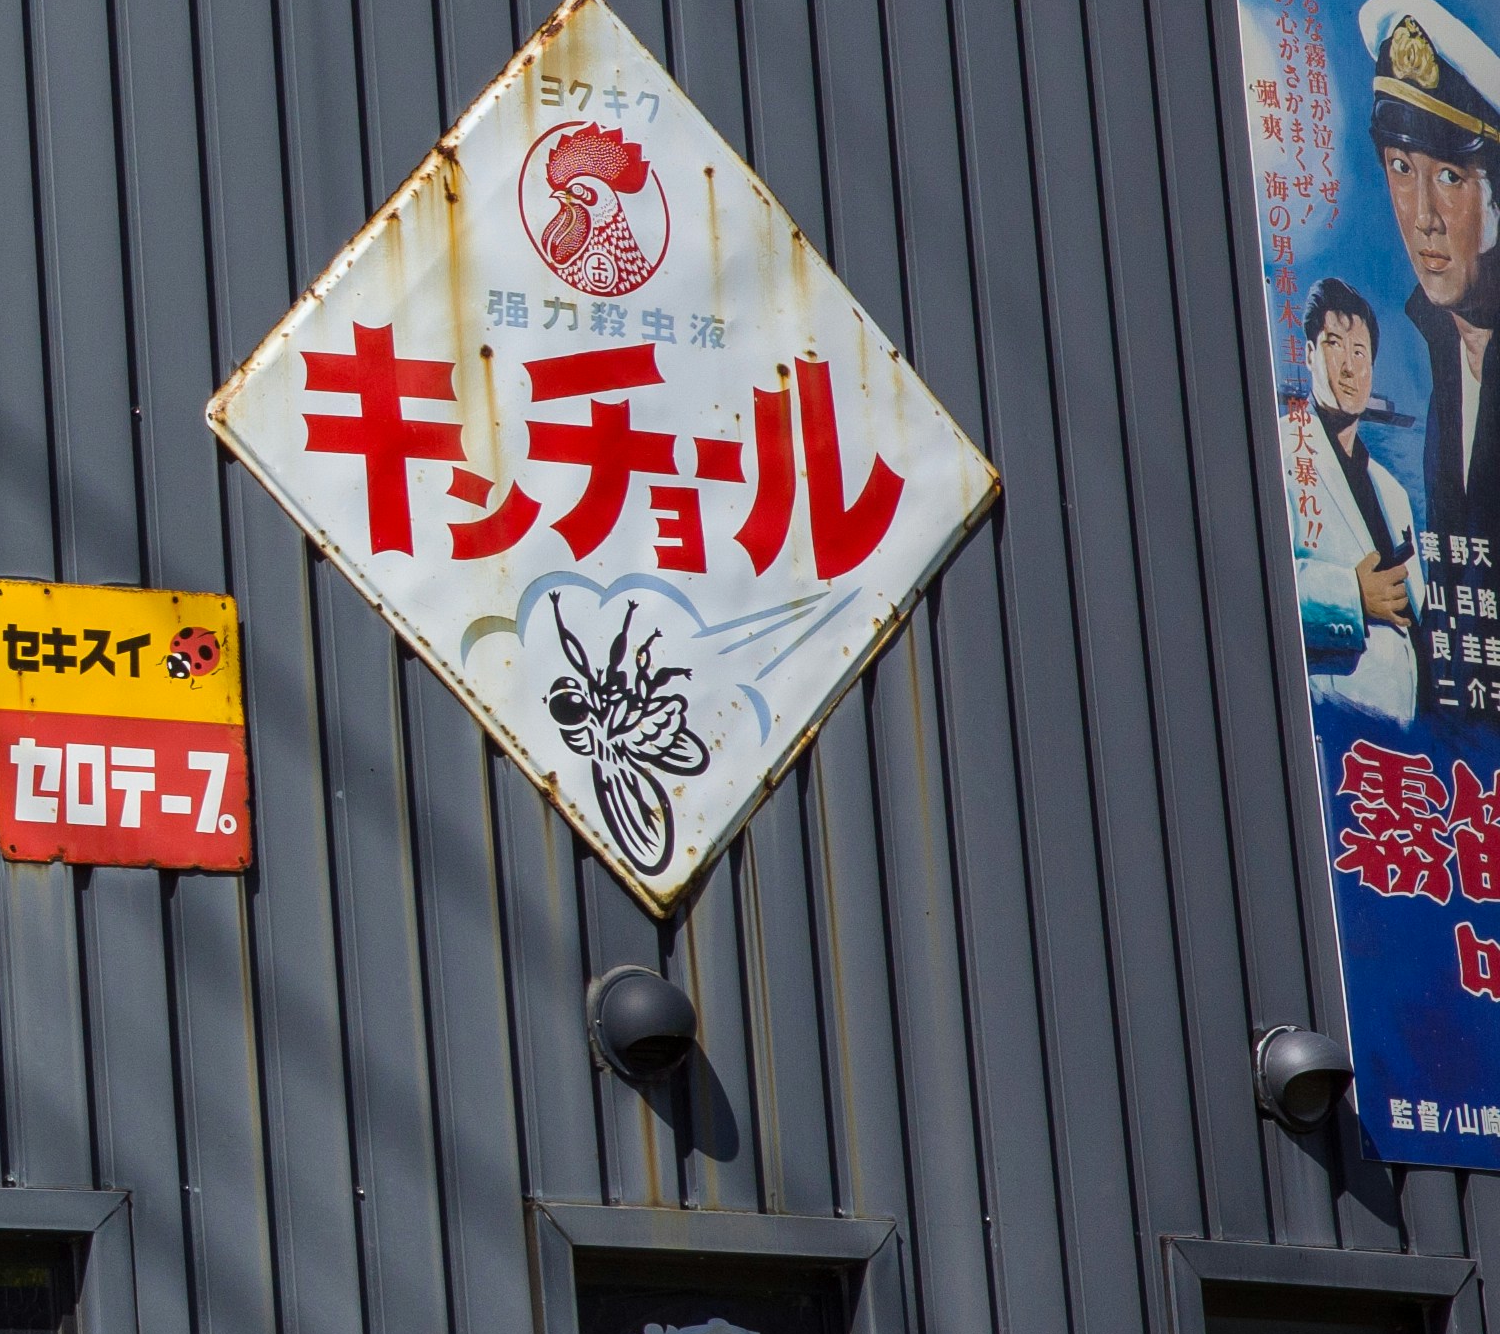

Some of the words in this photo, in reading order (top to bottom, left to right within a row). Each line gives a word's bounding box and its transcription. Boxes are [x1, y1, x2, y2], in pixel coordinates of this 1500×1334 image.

[541, 75, 660, 123] ヨクキク
[301, 322, 905, 580] キンチョール
[2, 623, 152, 678] セキスイ
[1420, 531, 1459, 706] 葉山良二
[1450, 535, 1486, 709] 野呂圭介
